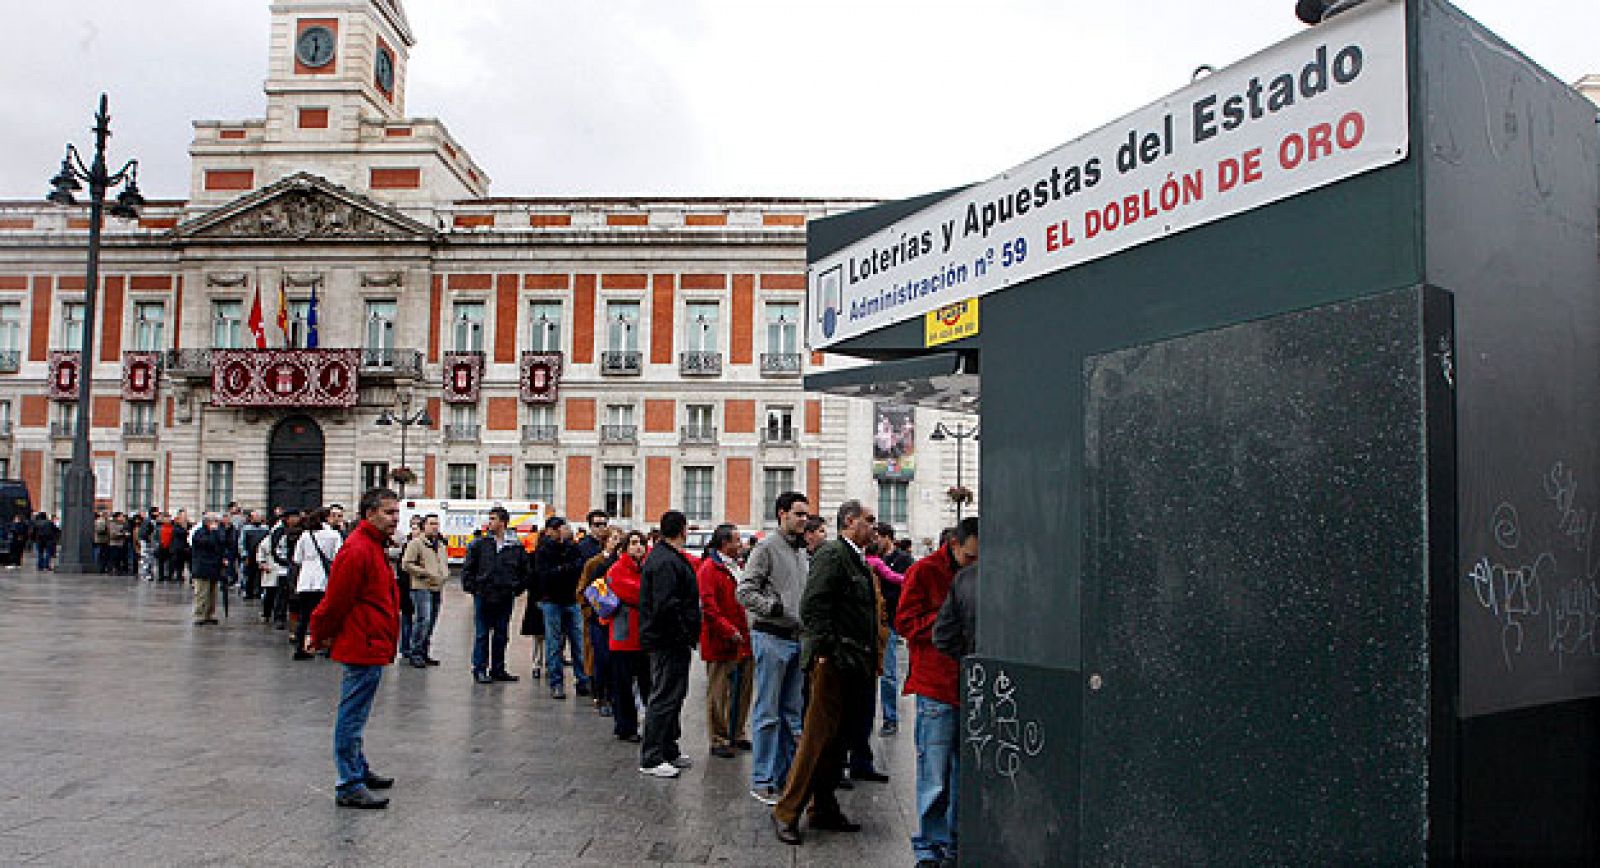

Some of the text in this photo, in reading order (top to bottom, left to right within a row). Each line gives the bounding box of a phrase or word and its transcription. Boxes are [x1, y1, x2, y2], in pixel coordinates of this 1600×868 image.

[849, 44, 1363, 285] Loterías y Apuestas del Estado
[1046, 111, 1366, 253] EL DOBLÓN DE ORO
[849, 261, 969, 321] Administración
[1002, 237, 1028, 267] 59
